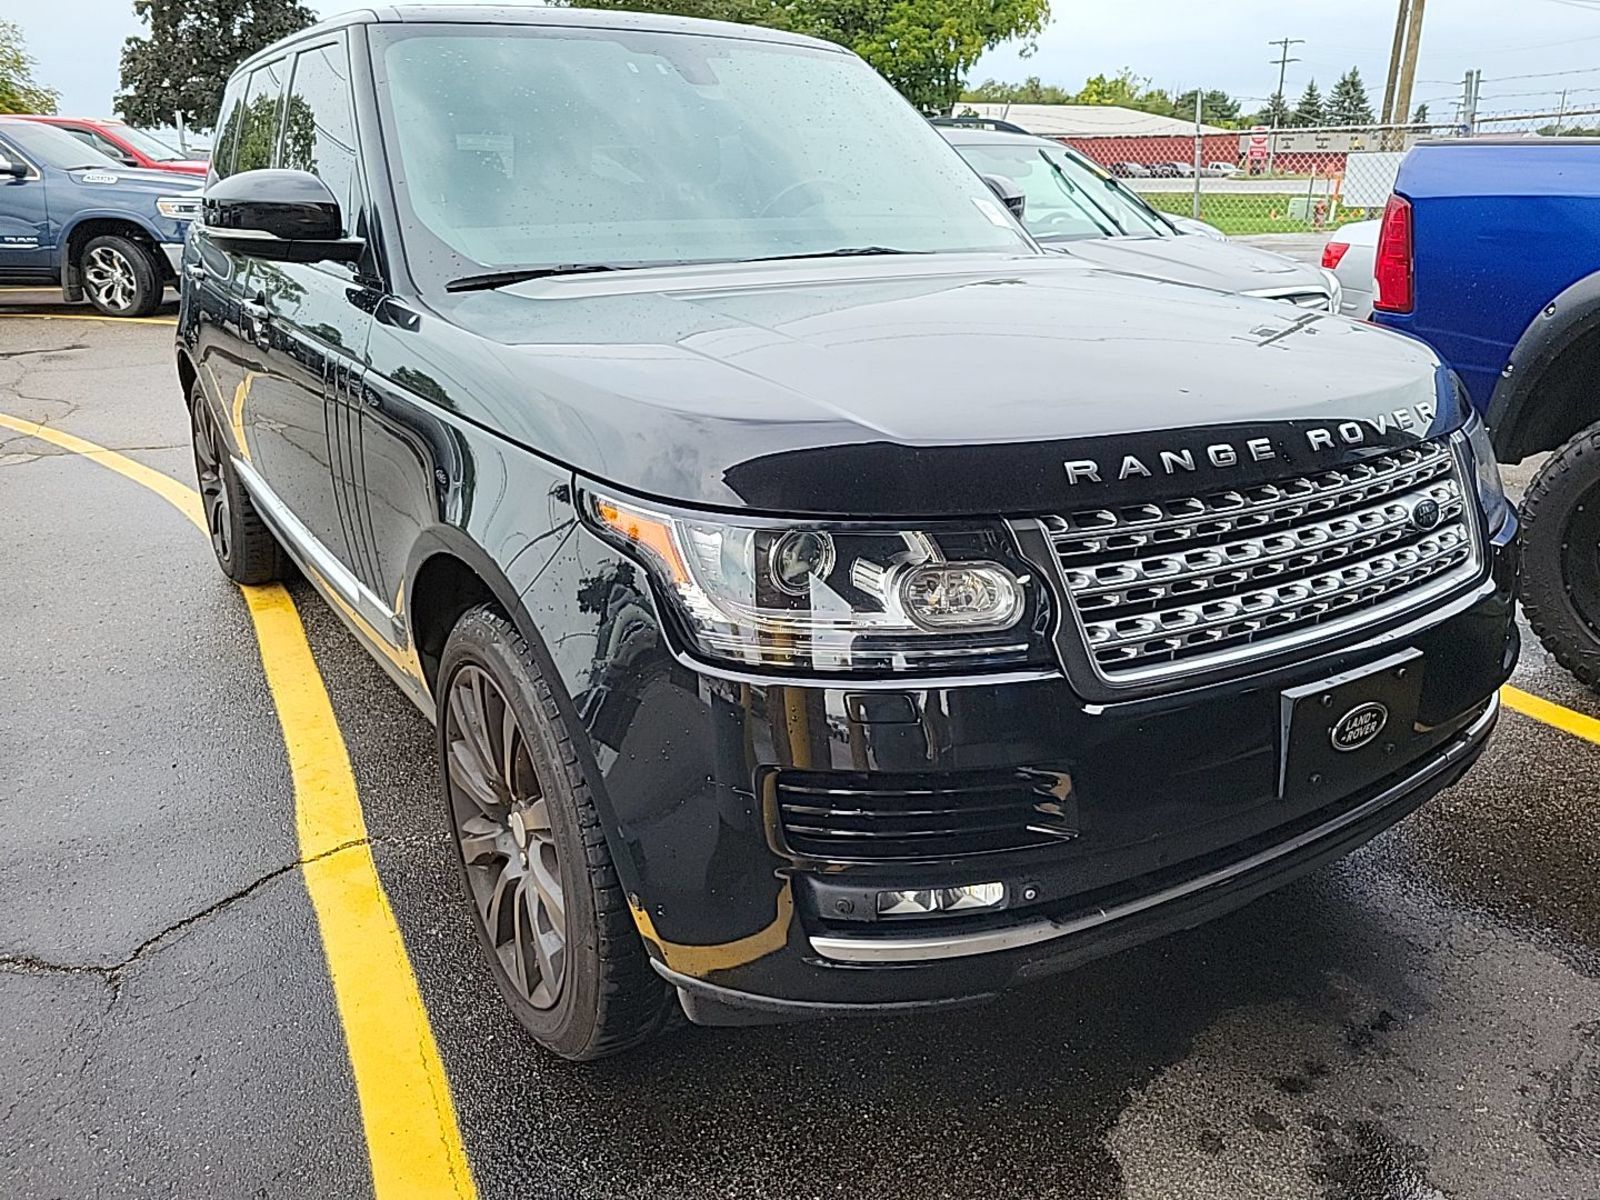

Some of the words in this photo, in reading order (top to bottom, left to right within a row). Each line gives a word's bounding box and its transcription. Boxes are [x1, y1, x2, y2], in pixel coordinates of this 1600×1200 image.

[1063, 437, 1276, 485] RANGE
[1306, 401, 1436, 452] ROVER
[1345, 712, 1372, 732] LAND
[1345, 720, 1378, 743] ROVER
